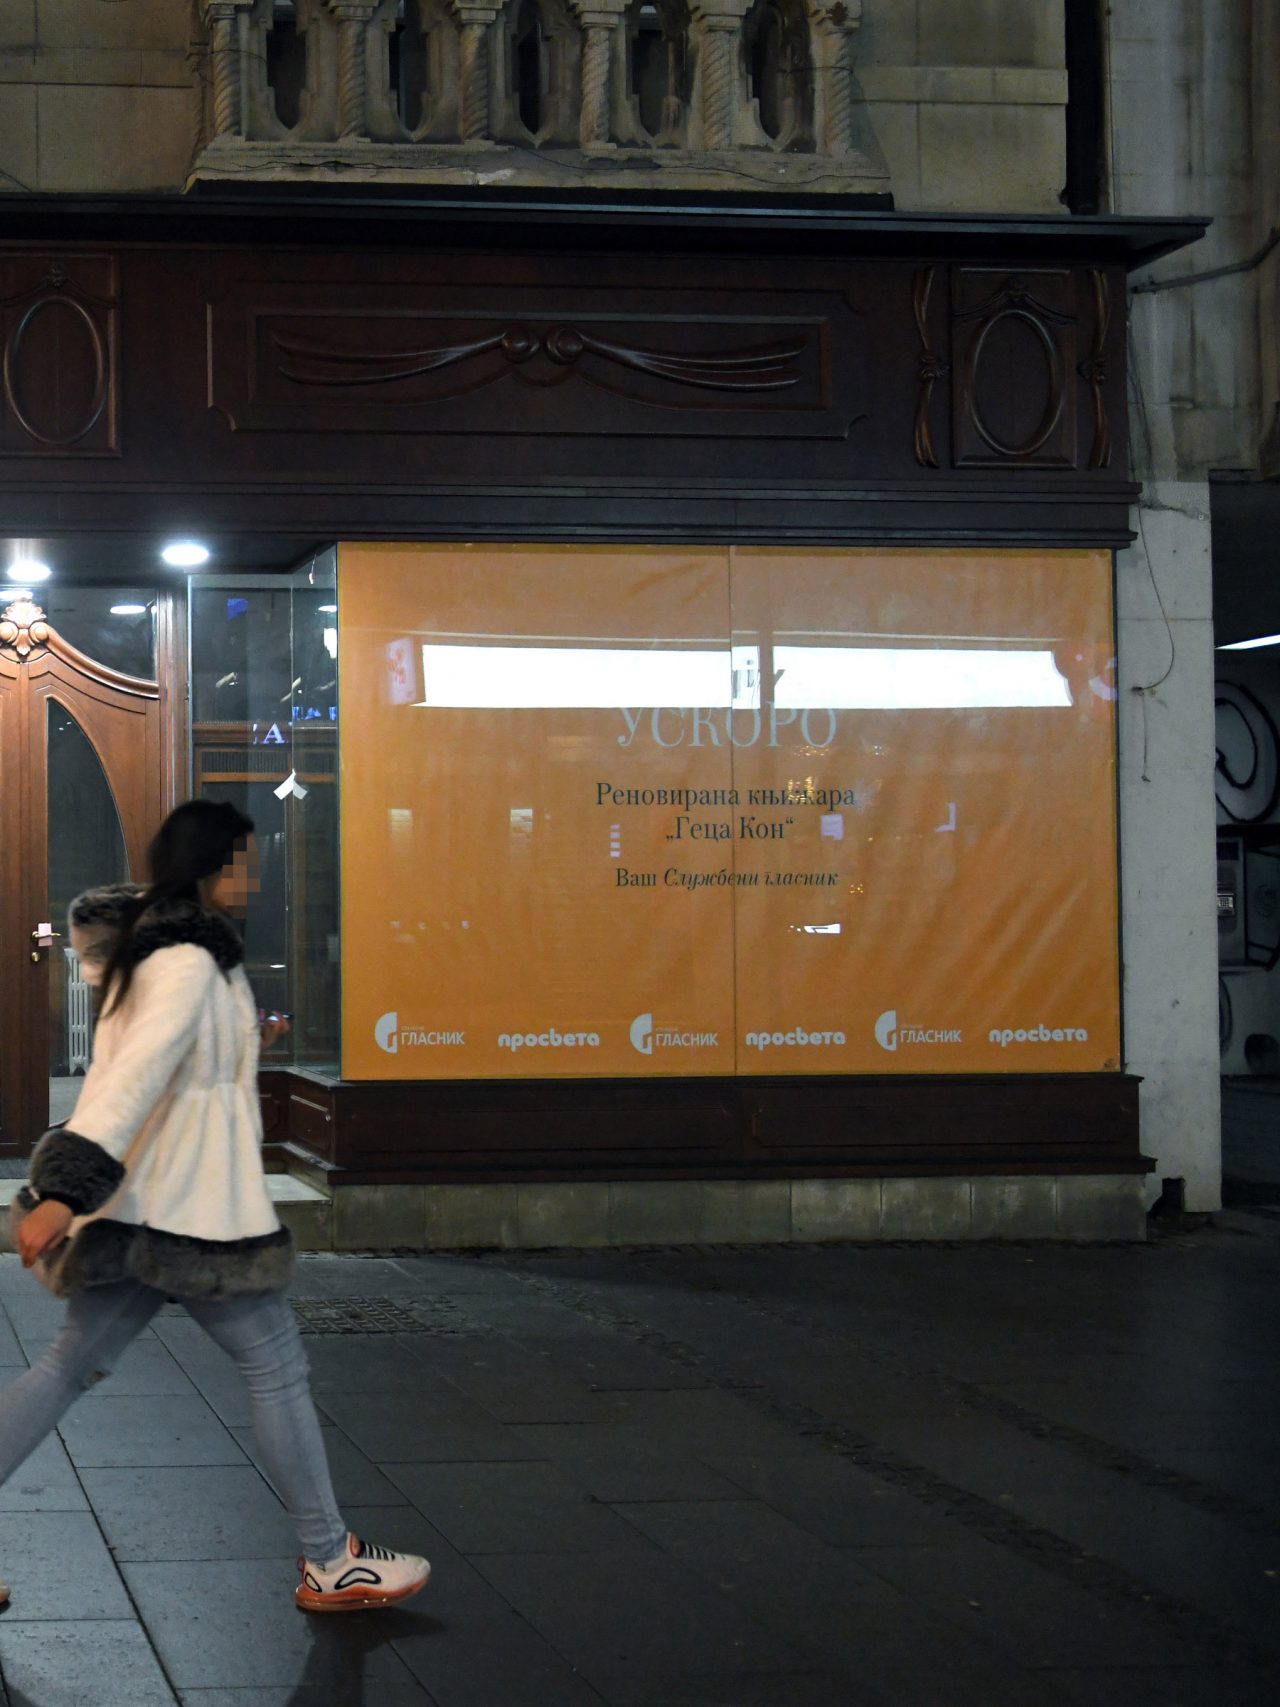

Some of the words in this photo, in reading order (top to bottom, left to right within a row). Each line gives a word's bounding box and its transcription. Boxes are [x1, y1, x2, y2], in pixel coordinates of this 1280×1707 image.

[617, 700, 838, 748] УСКОРО
[596, 782, 741, 811] Реновирана
[616, 868, 657, 887] Ваш
[664, 867, 759, 892] Службени
[401, 1031, 465, 1046] ГЛАСНИК
[497, 1028, 601, 1052] просвета
[655, 1033, 718, 1047] ГЛАСНИК
[745, 1026, 846, 1051] просвета
[900, 1029, 962, 1043] ГЛАСНИК
[988, 1024, 1088, 1047] просвета
